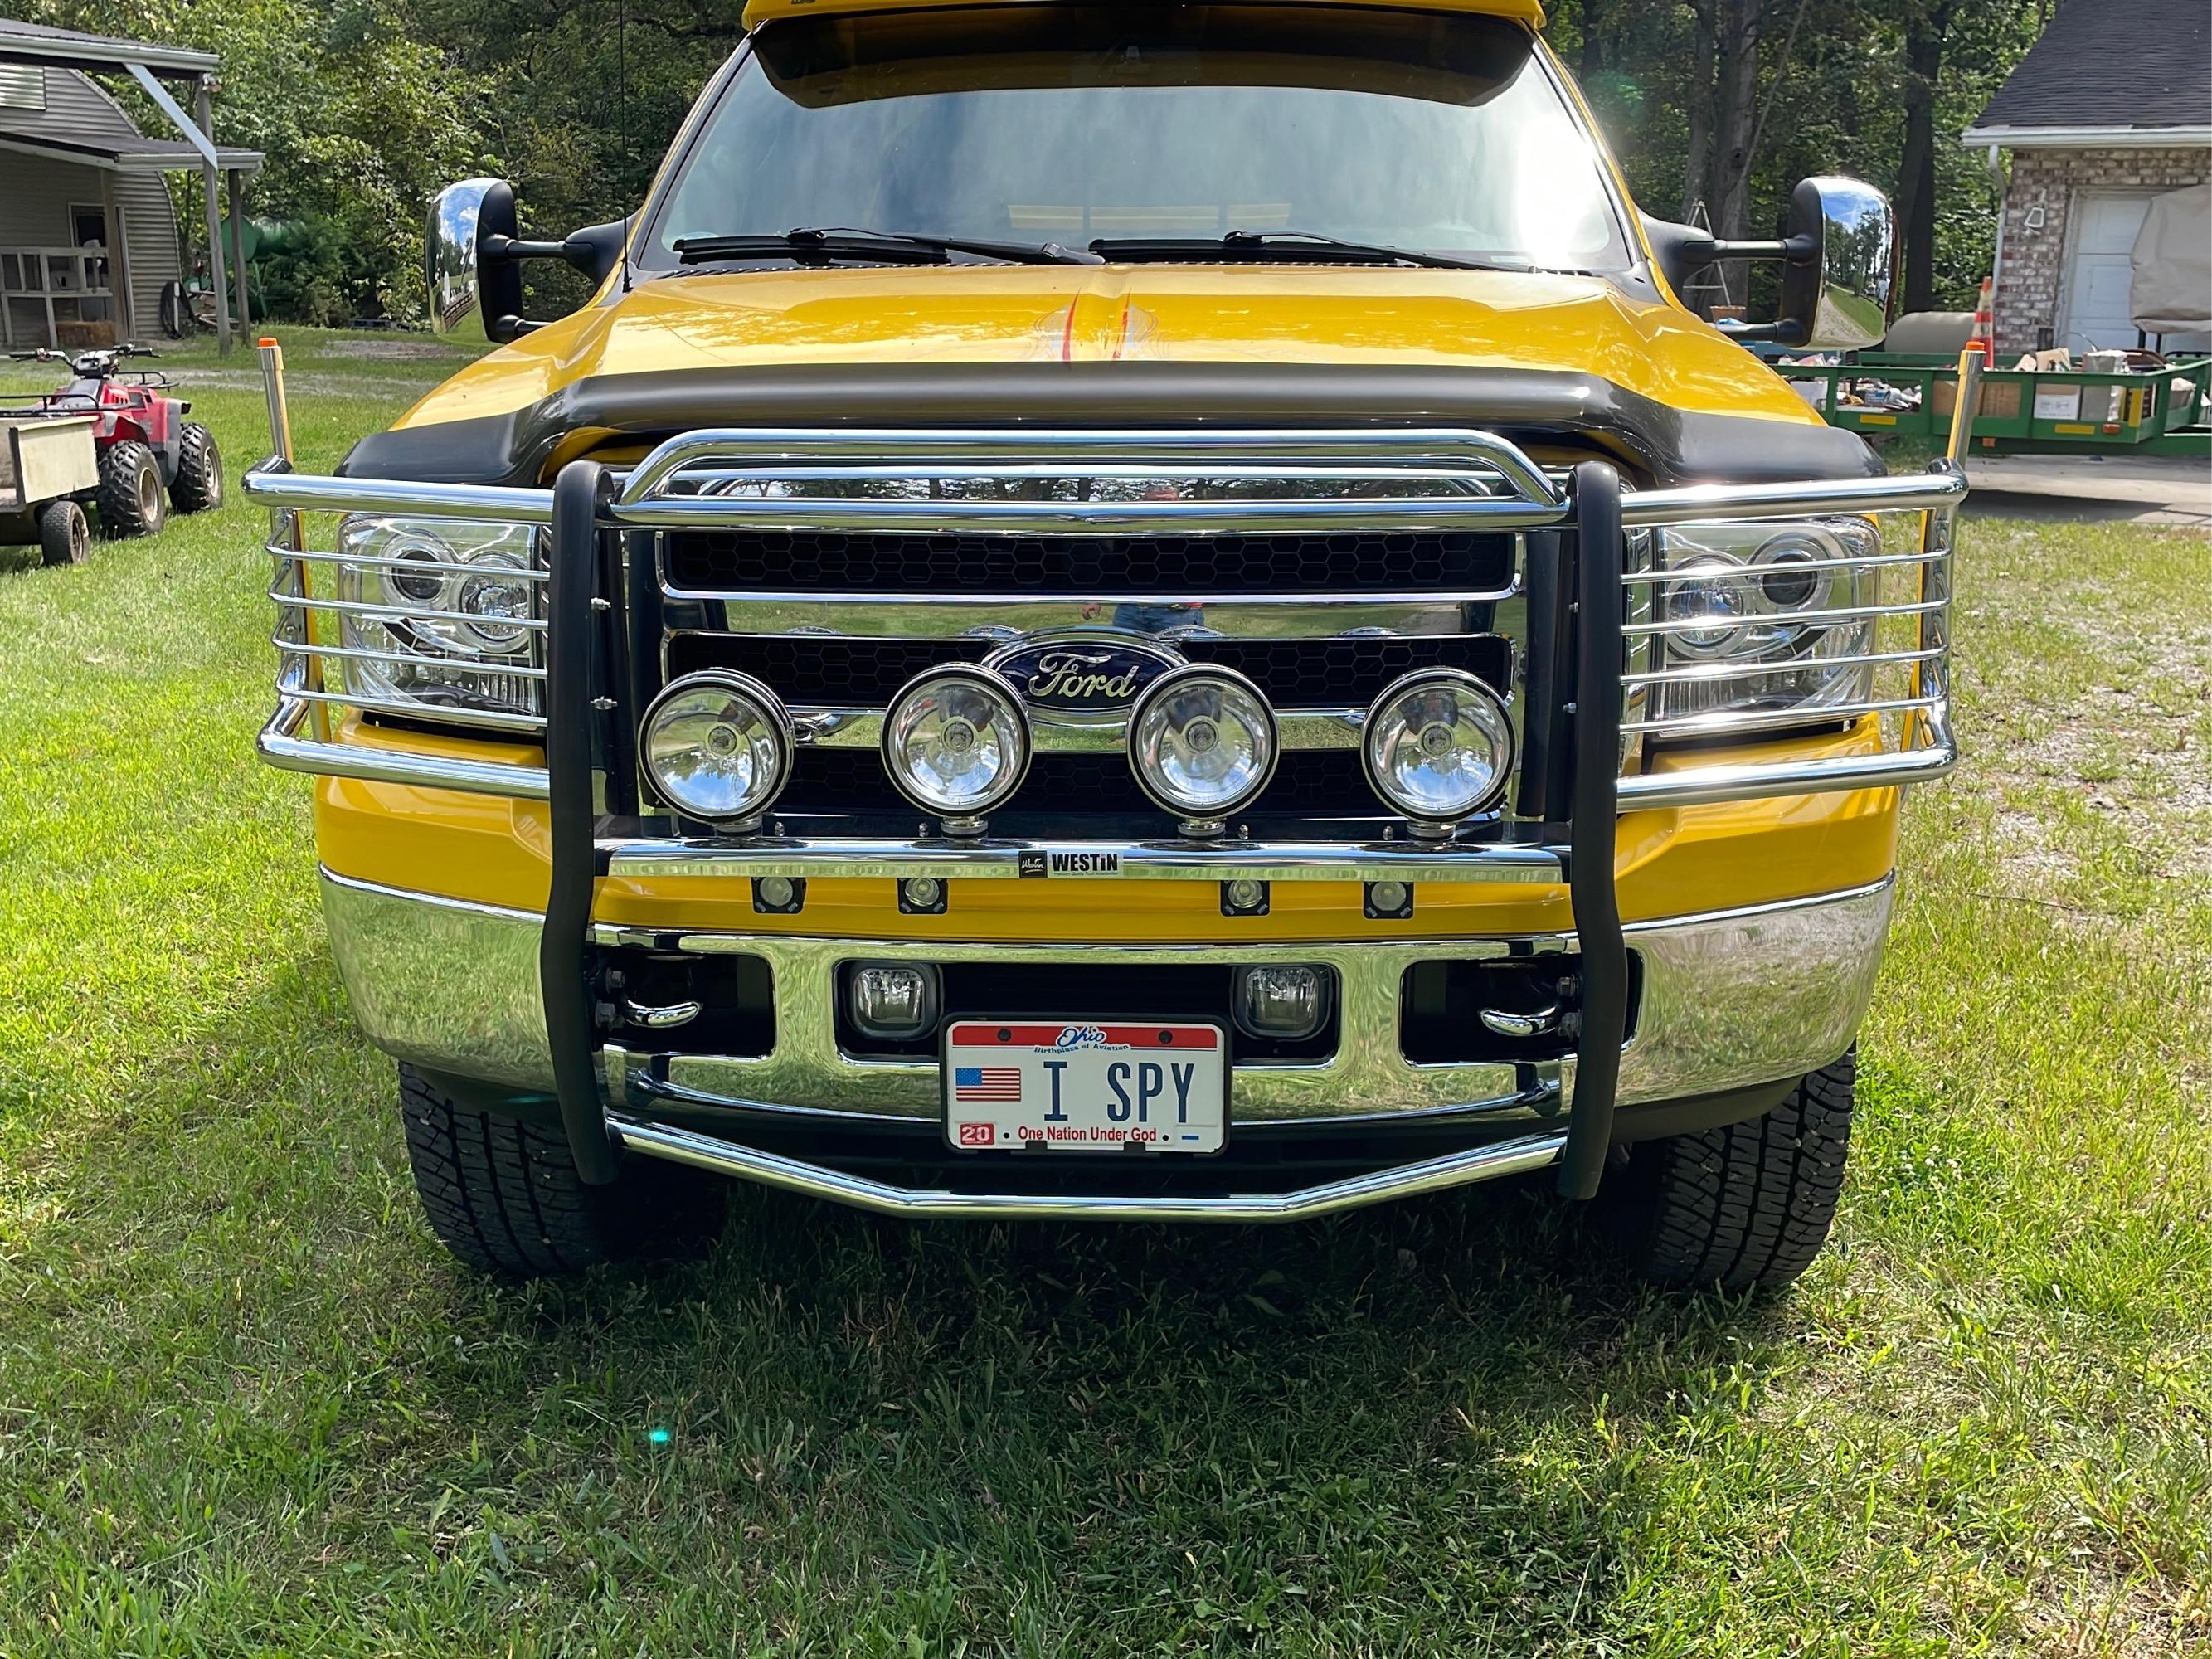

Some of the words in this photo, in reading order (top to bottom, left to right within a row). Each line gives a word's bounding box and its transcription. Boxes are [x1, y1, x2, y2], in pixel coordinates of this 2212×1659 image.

[1028, 653, 1139, 697] Ford
[1057, 1026, 1105, 1047] Ohio
[1033, 1046, 1079, 1054] Birthplace
[1043, 1061, 1068, 1121] I
[1107, 1063, 1194, 1123] SPY
[962, 1126, 990, 1141] 20
[1018, 1126, 1043, 1140] One
[1047, 1126, 1086, 1141] Nation
[1091, 1127, 1128, 1141] Under
[1131, 1128, 1157, 1141] God
